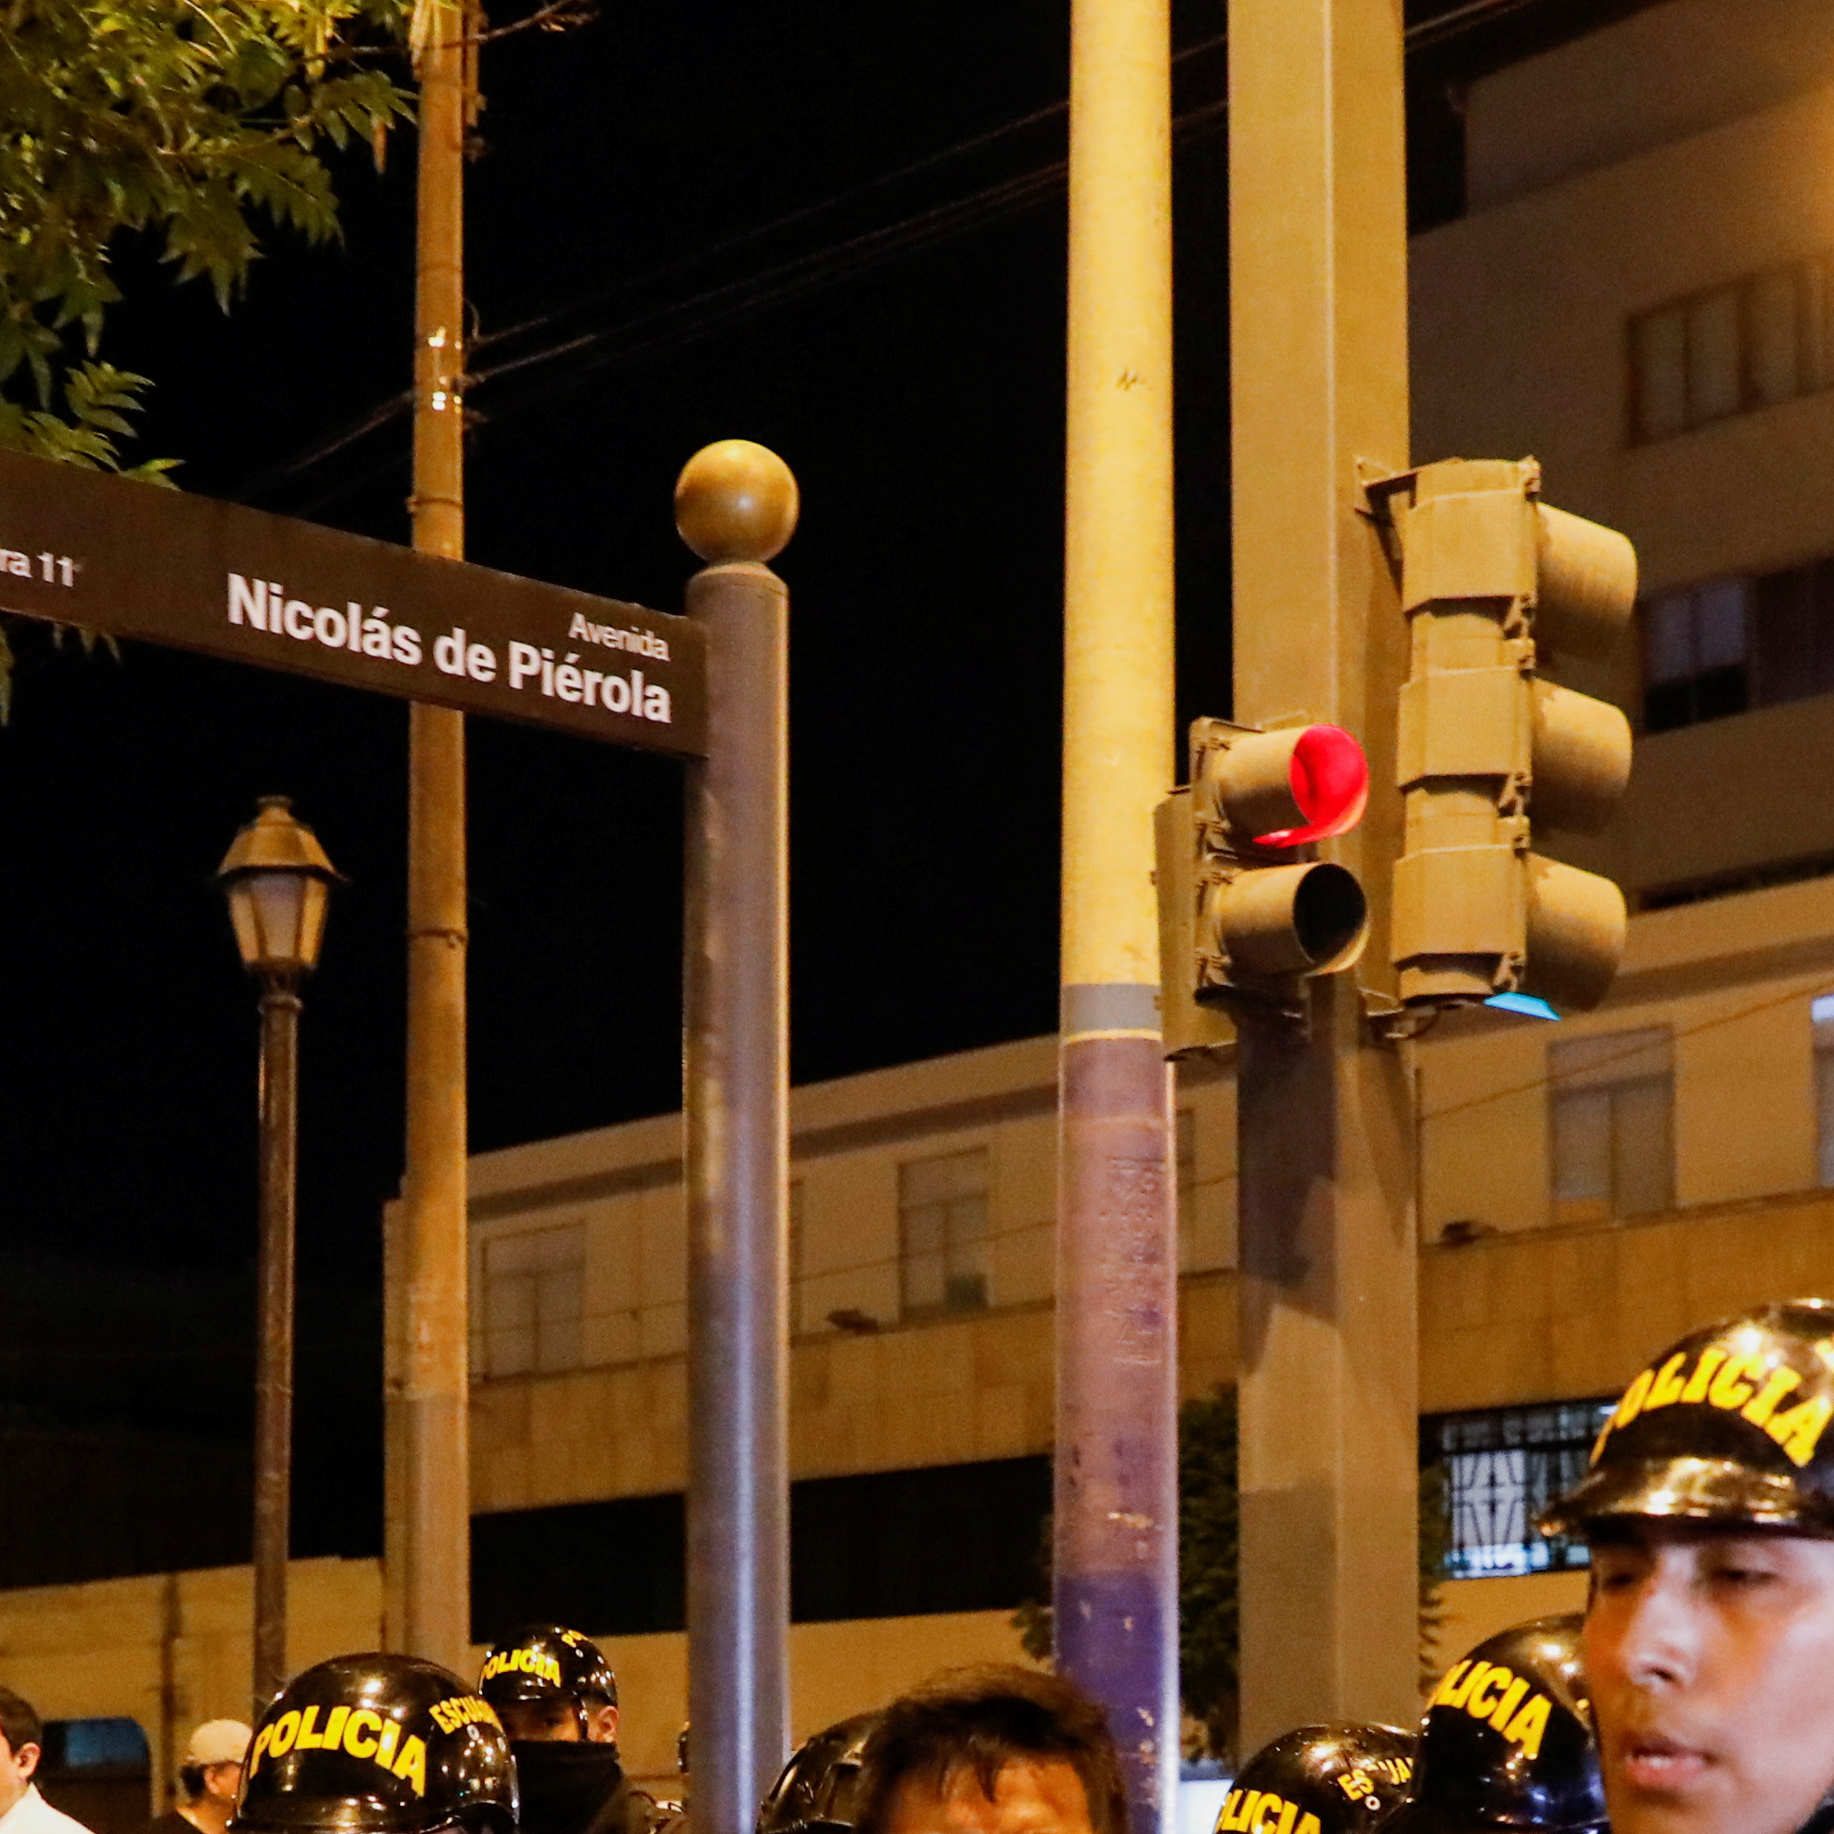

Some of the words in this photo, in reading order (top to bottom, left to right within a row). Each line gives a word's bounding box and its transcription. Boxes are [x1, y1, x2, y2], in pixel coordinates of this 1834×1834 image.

[36, 550, 75, 588] 11
[227, 572, 423, 666] Nicolás
[433, 626, 497, 683] de
[508, 640, 672, 724] Piérola
[568, 611, 671, 662] Avenida
[1589, 1347, 1834, 1467] OLICIA
[249, 1705, 427, 1797] POLICIA
[1425, 1659, 1553, 1760] LICIA
